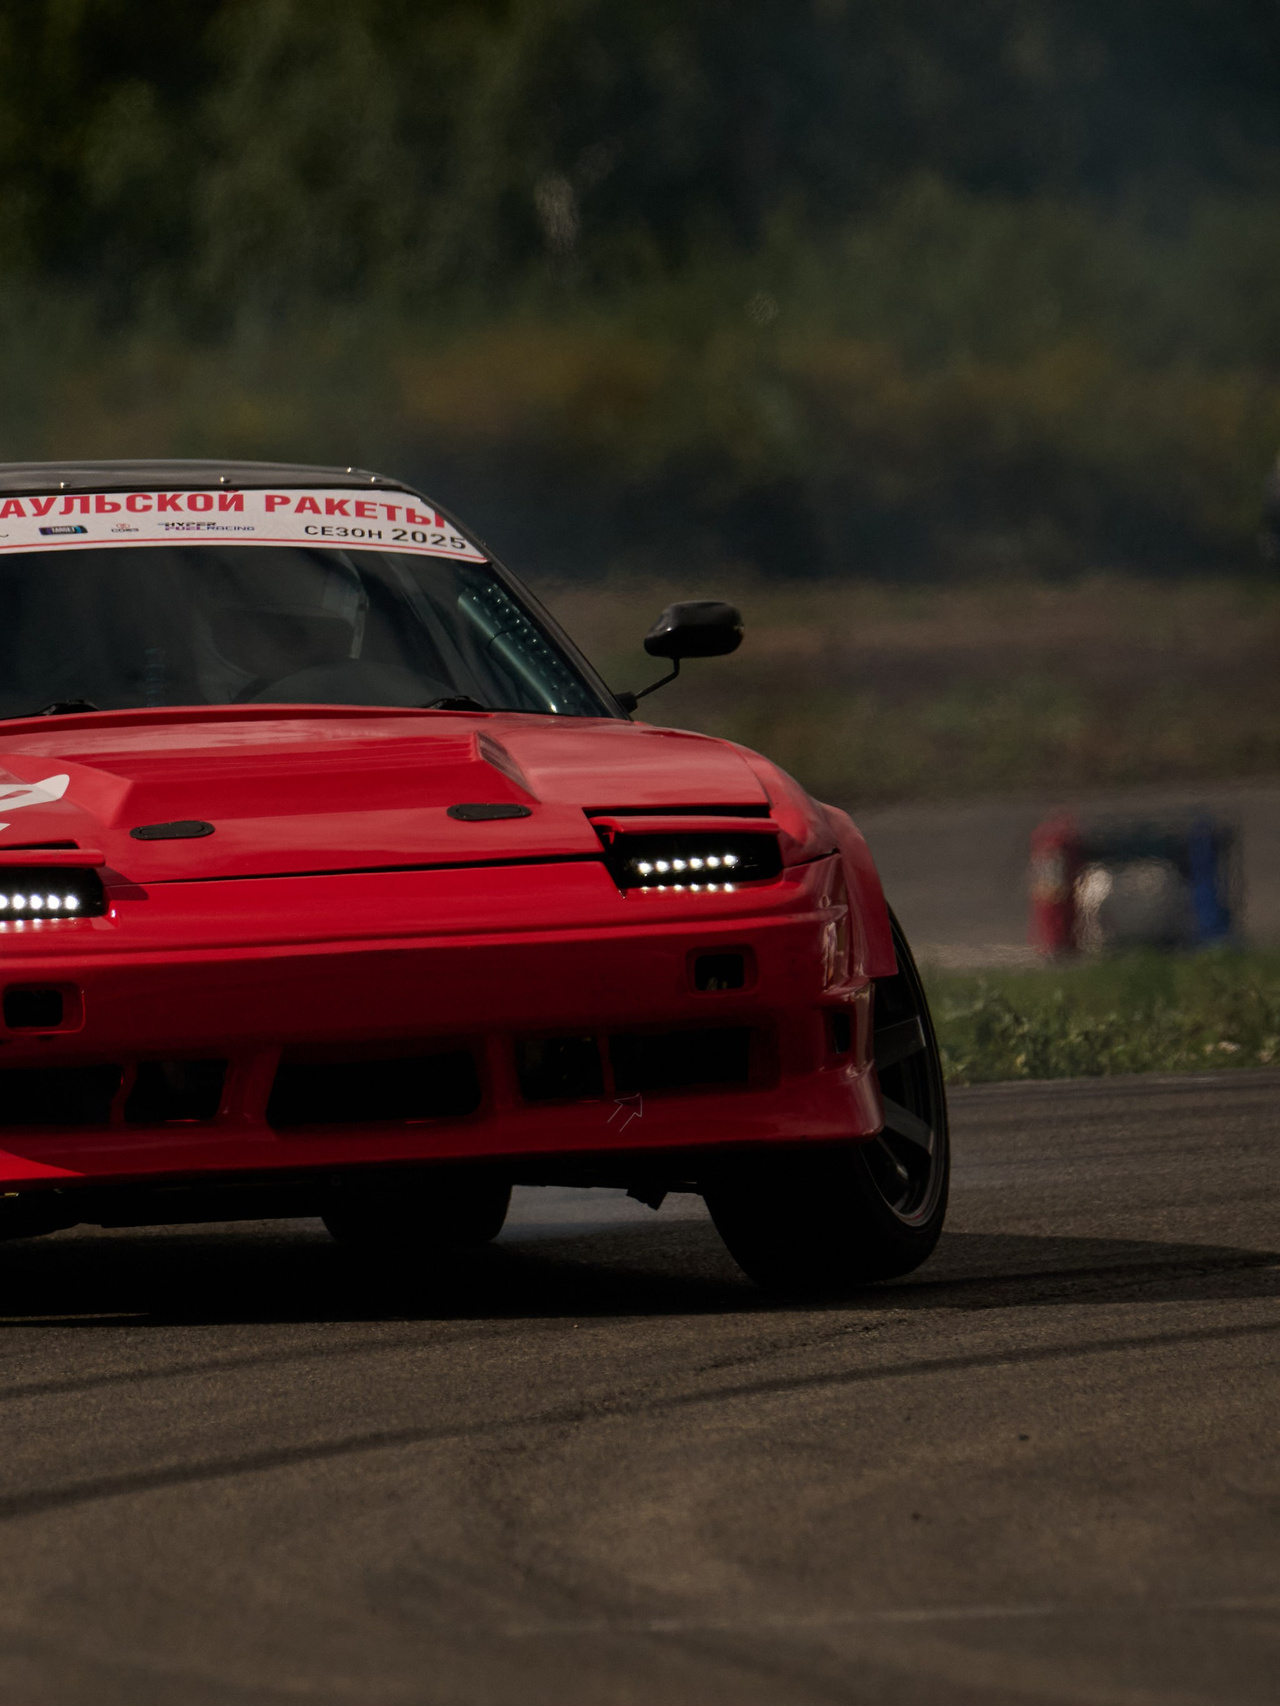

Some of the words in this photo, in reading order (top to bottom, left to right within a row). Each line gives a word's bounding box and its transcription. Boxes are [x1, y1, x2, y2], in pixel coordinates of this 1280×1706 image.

[265, 494, 445, 528] РАКЕТЫ
[304, 524, 383, 540] СЕЗОН
[391, 528, 467, 550] 2025
